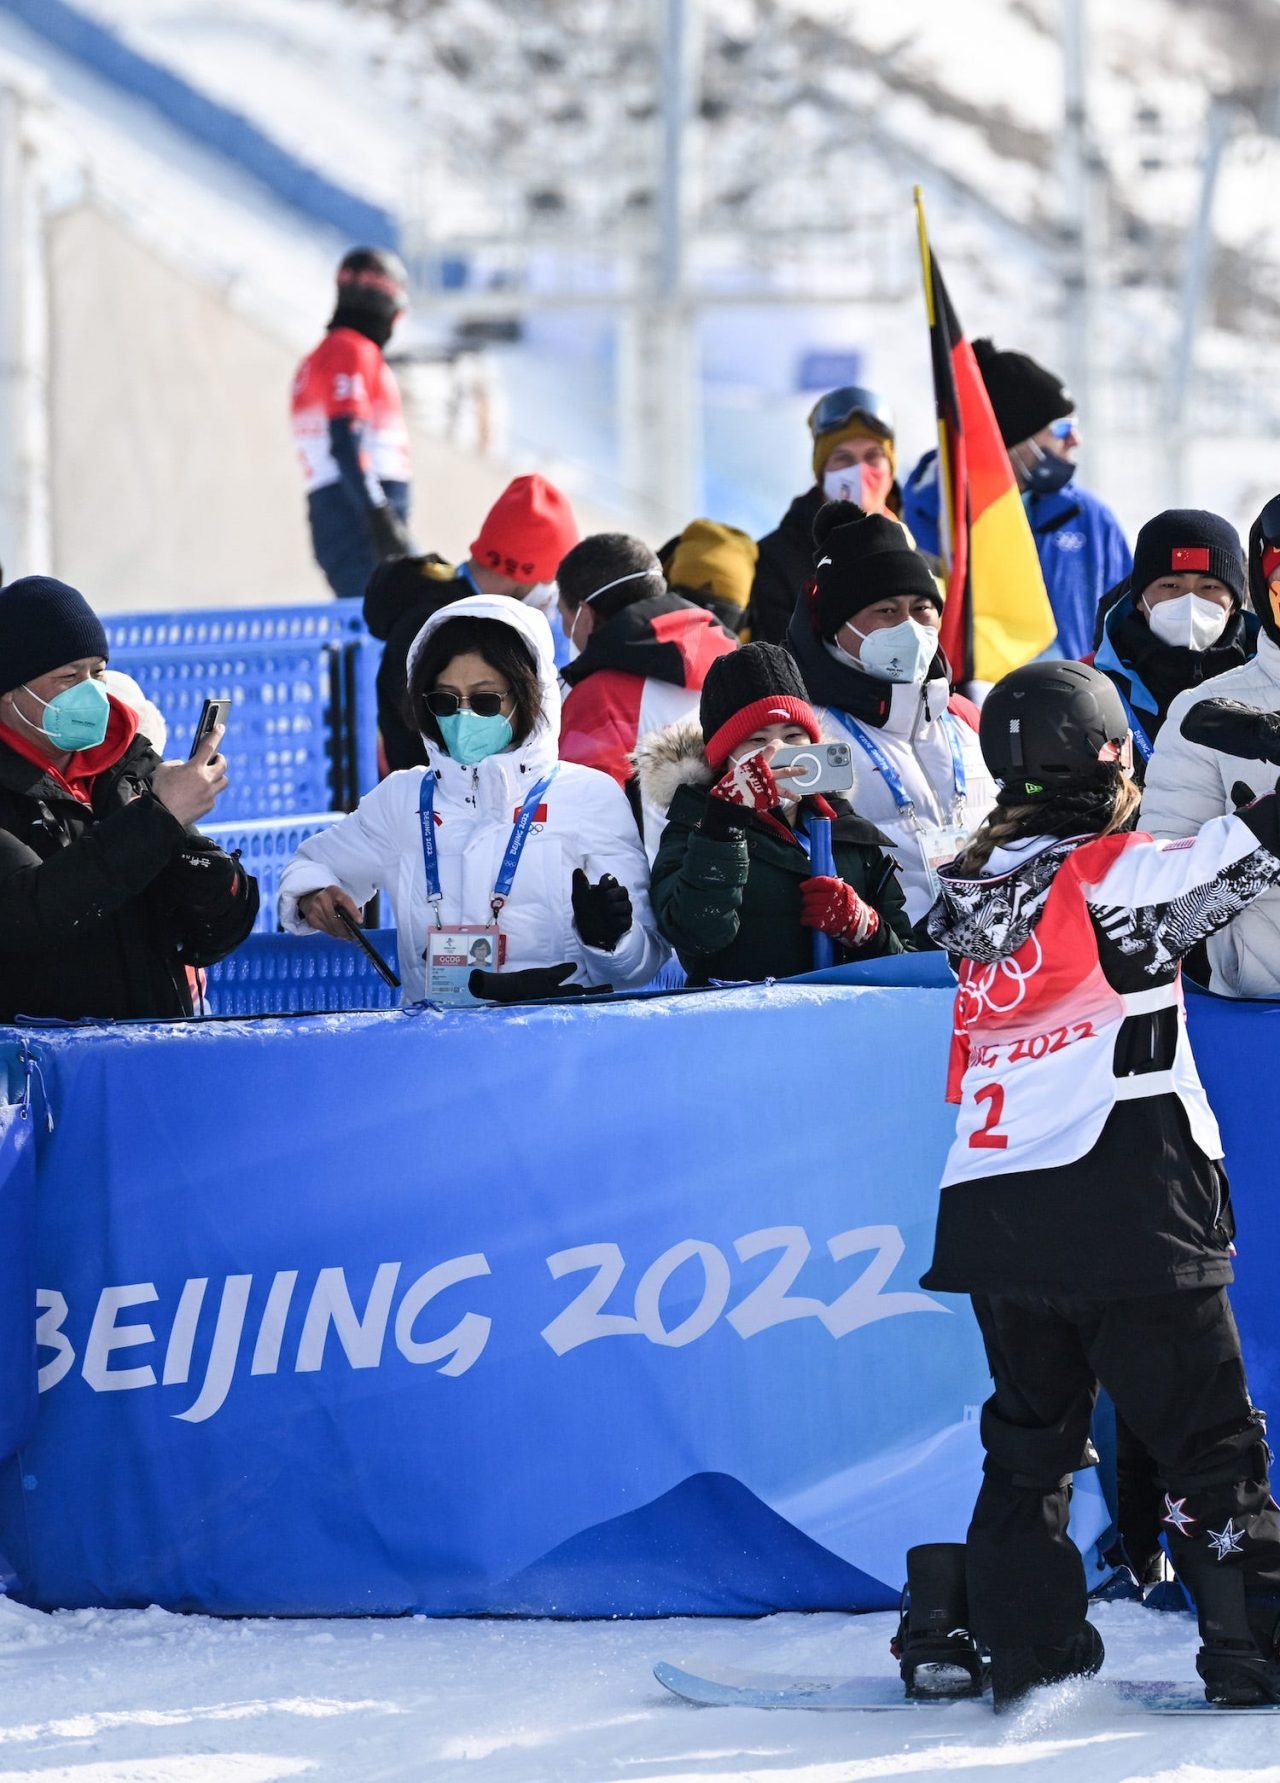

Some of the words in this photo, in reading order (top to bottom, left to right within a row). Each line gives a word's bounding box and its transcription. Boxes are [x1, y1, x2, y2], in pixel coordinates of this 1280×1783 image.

[423, 810, 432, 837] BEIJING
[509, 830, 524, 856] BEIJING
[520, 812, 530, 830] 2022
[425, 838, 434, 857] 2022
[1007, 1021, 1098, 1064] 2022
[968, 1082, 1009, 1149] 2
[540, 1224, 955, 1357] 2022
